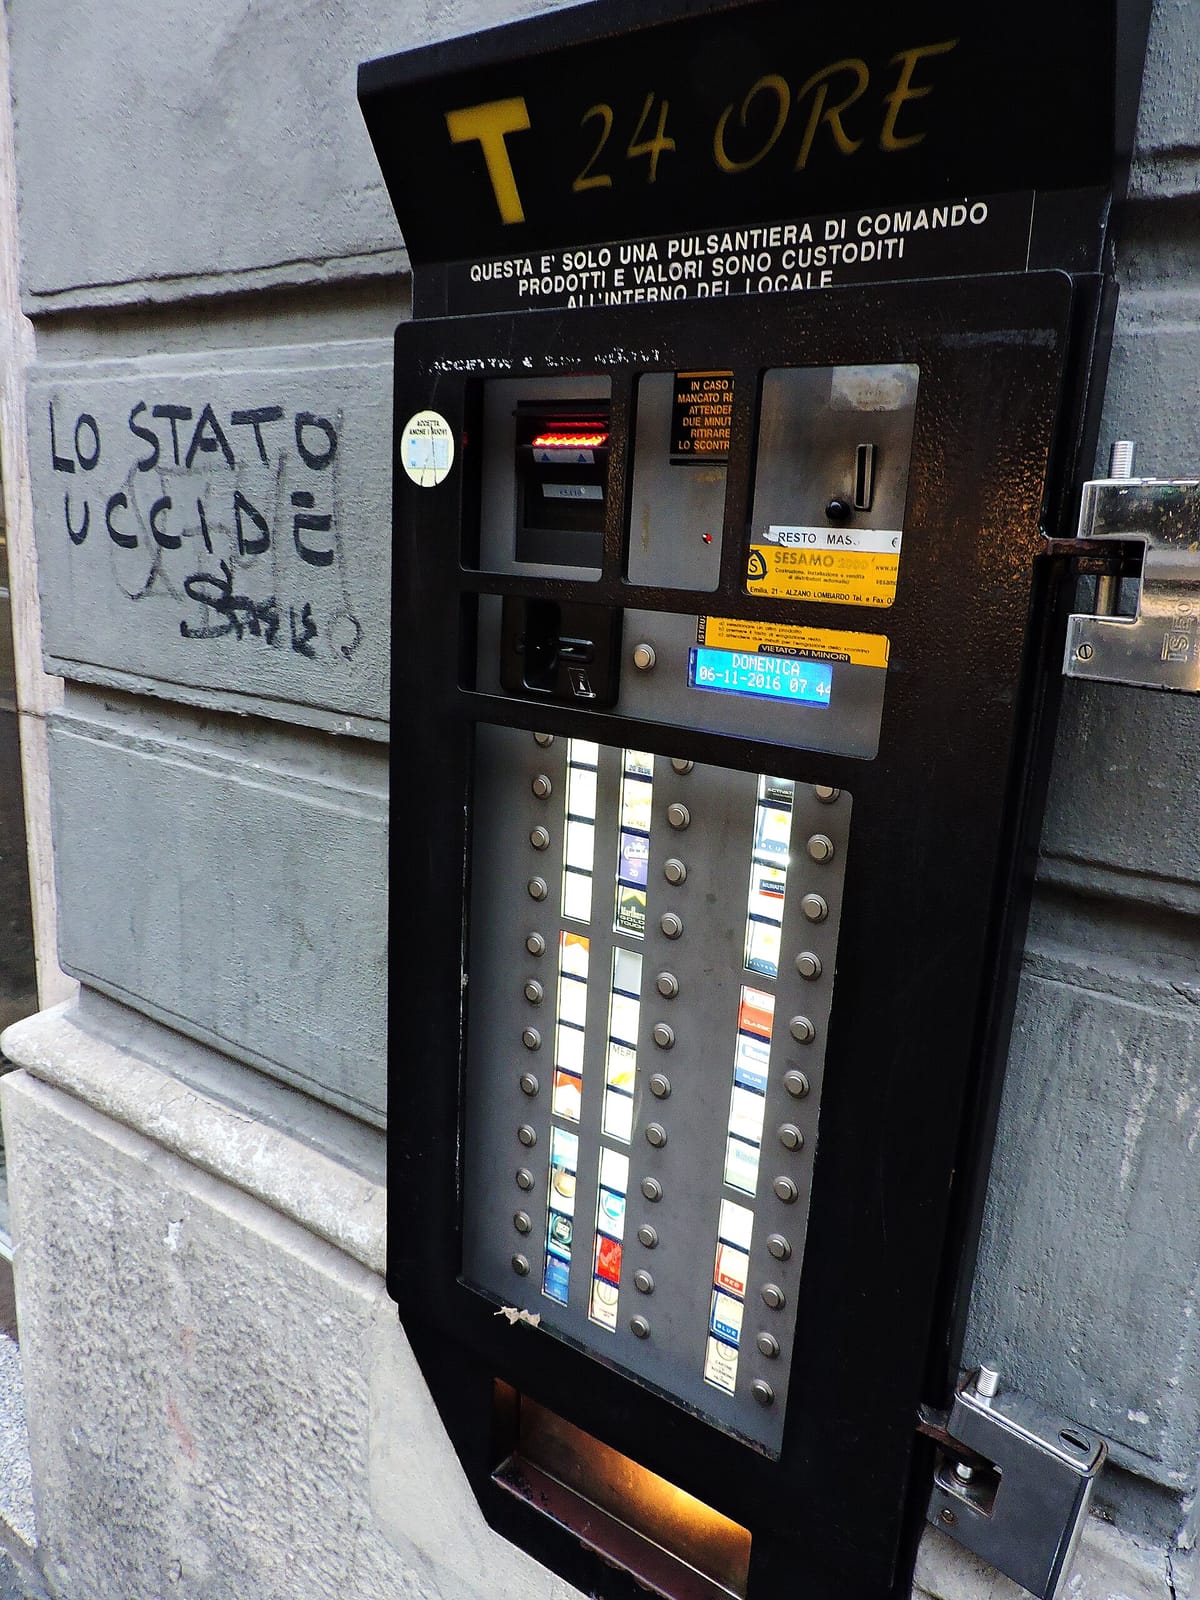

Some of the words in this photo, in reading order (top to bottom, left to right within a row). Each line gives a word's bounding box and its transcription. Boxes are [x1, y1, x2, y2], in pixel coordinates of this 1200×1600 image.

[444, 97, 531, 225] T
[572, 91, 677, 192] 24
[713, 38, 960, 173] ORE
[470, 258, 533, 282] QUESTA
[541, 255, 556, 273] E'
[562, 248, 611, 272] SOLO
[619, 242, 658, 265] UNA
[668, 223, 813, 258] PULSANTIERA
[824, 219, 846, 241] DI
[857, 202, 988, 237] COMANDO
[518, 270, 606, 297] PRODOTTI
[614, 268, 625, 287] E
[633, 260, 703, 285] VALORI
[712, 252, 772, 277] SONO
[782, 238, 904, 270] CUSTODITI
[691, 381, 700, 391] IN
[703, 380, 729, 391] CASO
[677, 393, 720, 403] MANCATO
[682, 416, 701, 427] DUE
[49, 400, 100, 474] LO
[129, 400, 338, 472] STATO
[690, 428, 731, 438] RITIRARE
[679, 440, 690, 450] LO
[64, 490, 335, 567] UCCIDE
[778, 532, 817, 544] RESTO
[748, 558, 758, 573] S
[774, 551, 834, 567] SESAMO
[786, 589, 811, 597] ALZANO
[813, 591, 850, 600] LOMBARDO
[1166, 599, 1193, 663] ISEO
[761, 644, 797, 655] VIETATO
[811, 650, 849, 661] MINORI
[732, 654, 800, 676] DOMENICA
[699, 666, 781, 691] 06-11-2016
[789, 679, 808, 694] 07
[716, 1322, 737, 1336] BLUE
